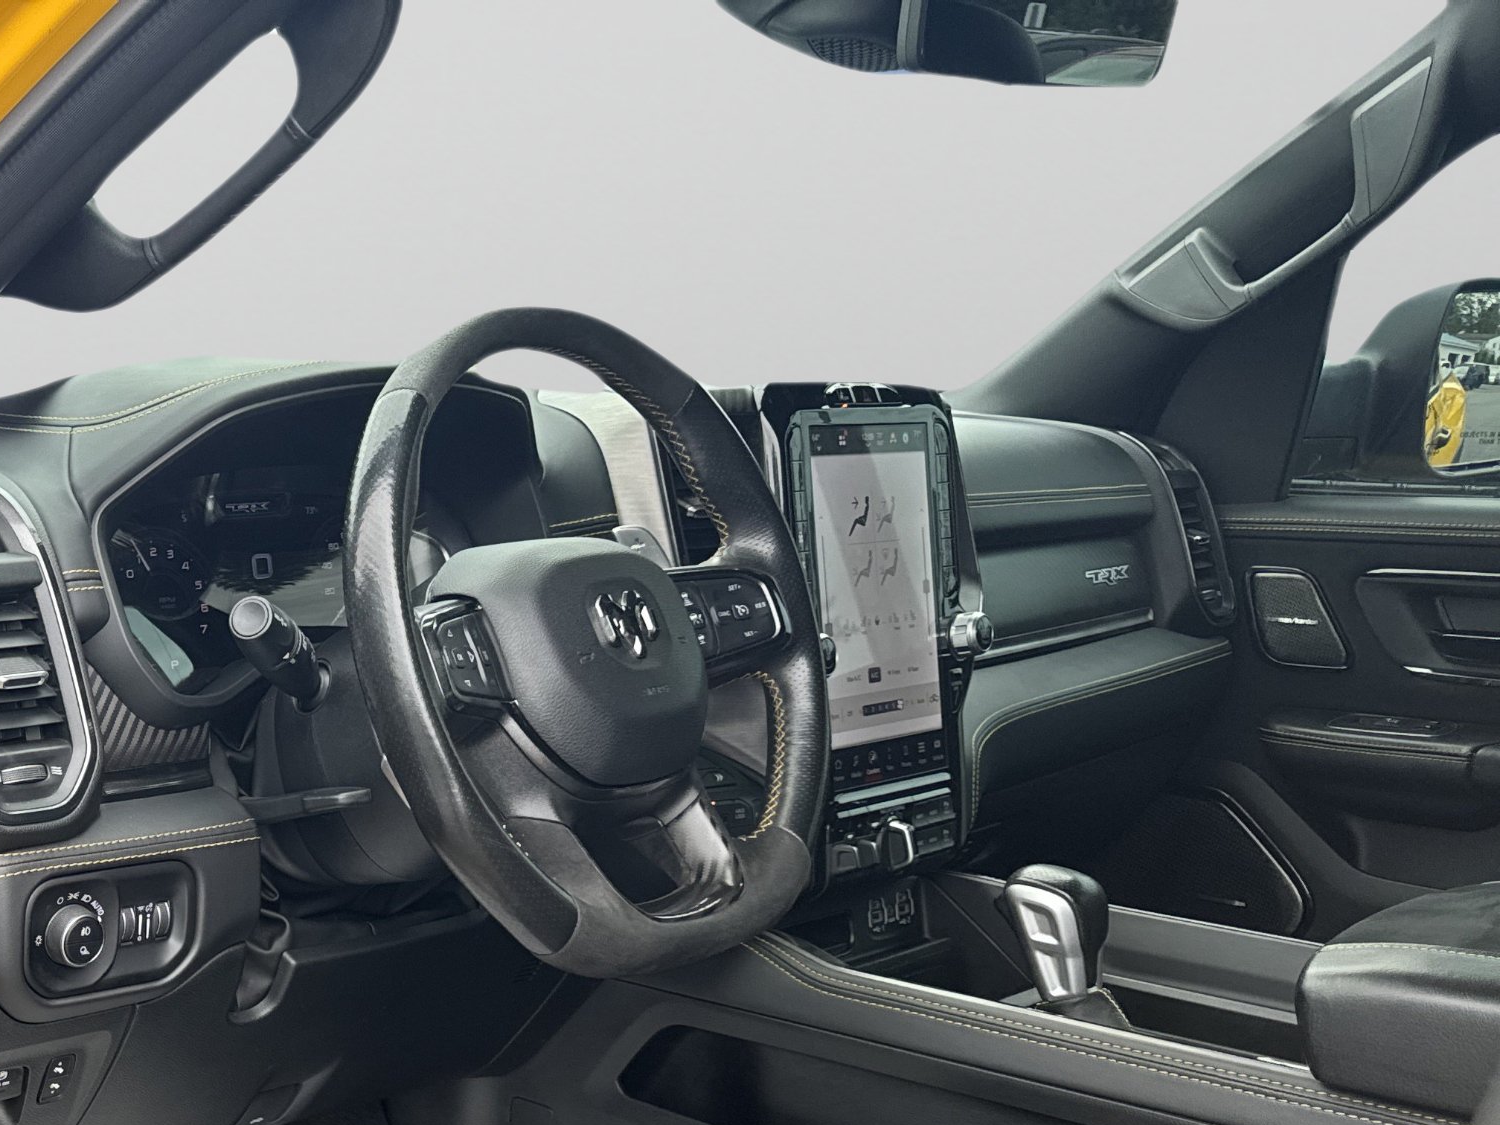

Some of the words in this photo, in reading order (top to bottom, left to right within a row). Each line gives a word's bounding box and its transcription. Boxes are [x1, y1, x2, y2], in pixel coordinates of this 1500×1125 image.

[150, 548, 158, 557] 2
[167, 550, 174, 559] 3
[181, 561, 190, 570] 4
[251, 553, 274, 580] 0
[1085, 564, 1129, 585] TRX
[194, 580, 202, 589] 5
[201, 604, 208, 613] 6
[200, 624, 207, 634] 7
[170, 660, 178, 670] P
[90, 900, 104, 915] AUTO
